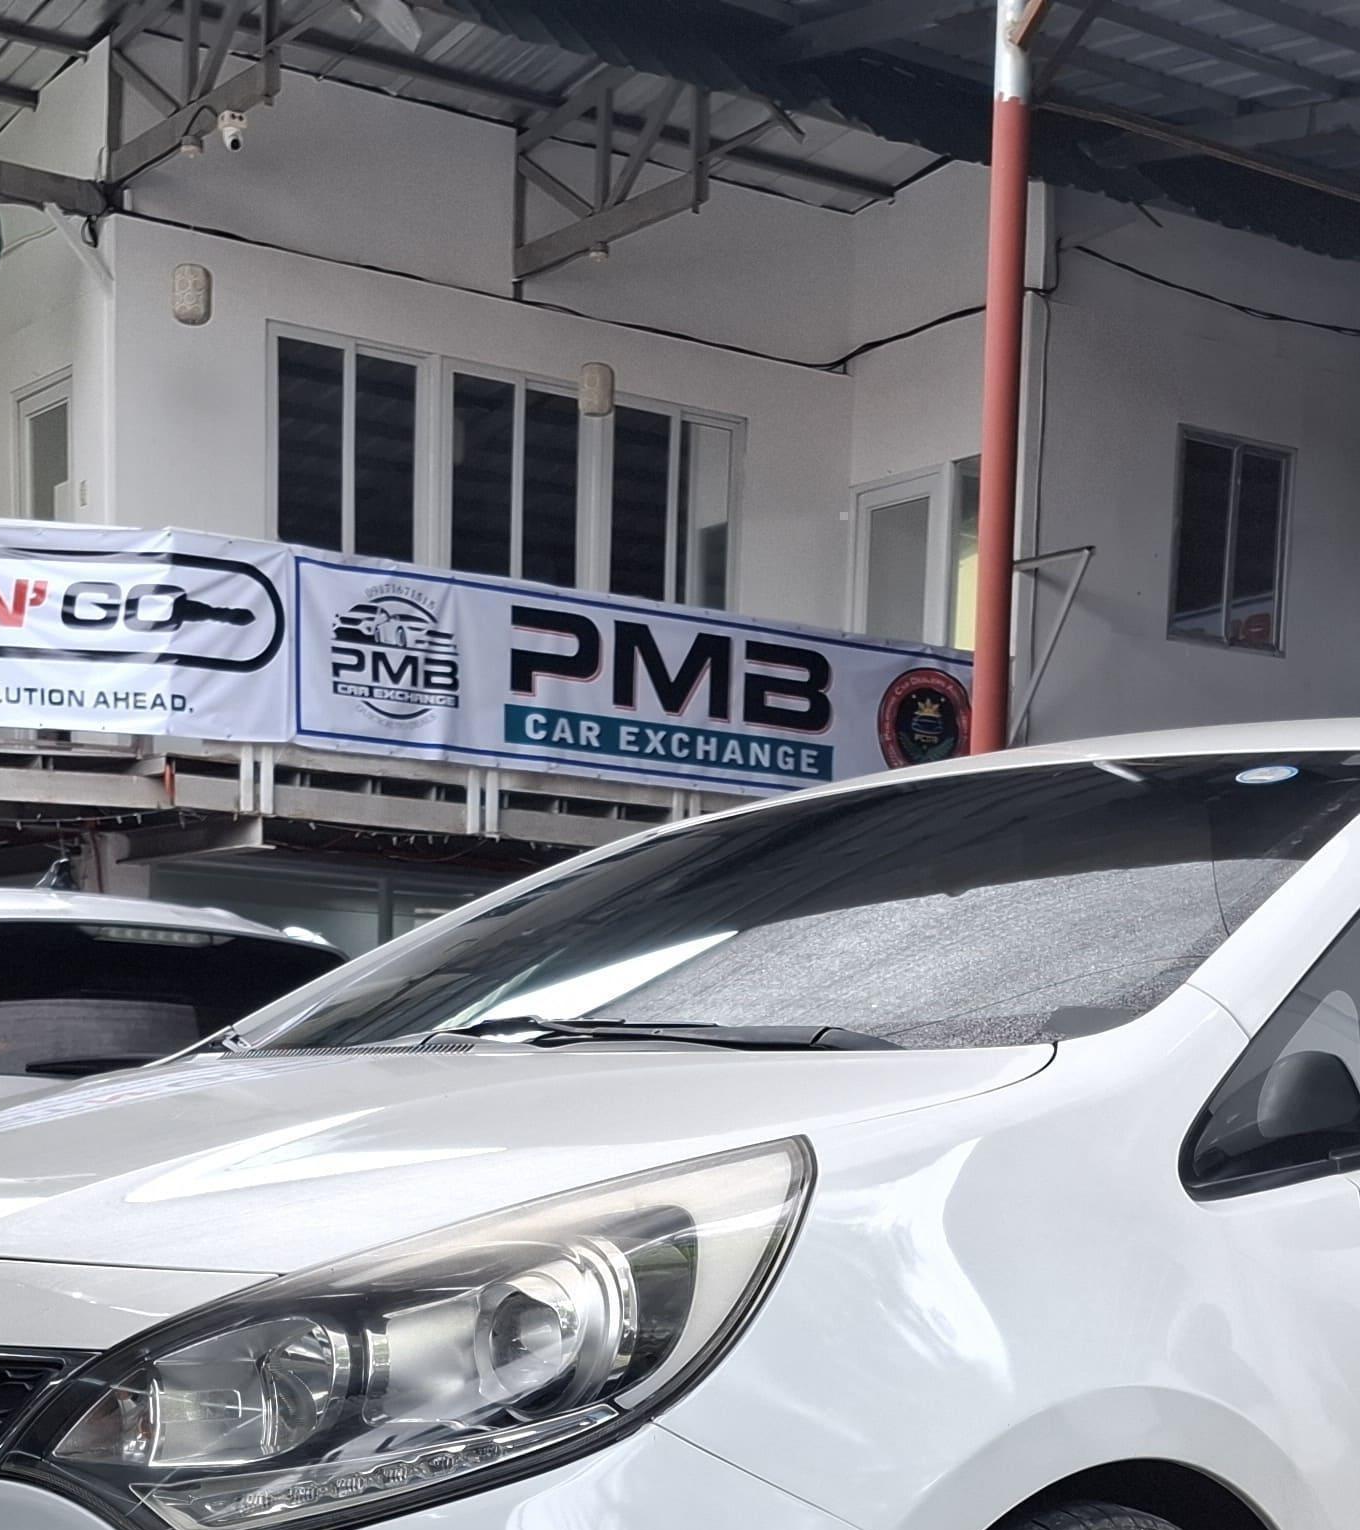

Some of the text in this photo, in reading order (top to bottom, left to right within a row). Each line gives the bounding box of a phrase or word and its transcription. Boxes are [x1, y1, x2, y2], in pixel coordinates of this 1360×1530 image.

[60, 580, 190, 633] GO
[330, 645, 460, 693] PMB
[509, 604, 833, 735] PMB
[92, 690, 195, 714] AHEAD.
[523, 712, 822, 775] CAR EXCHANGE
